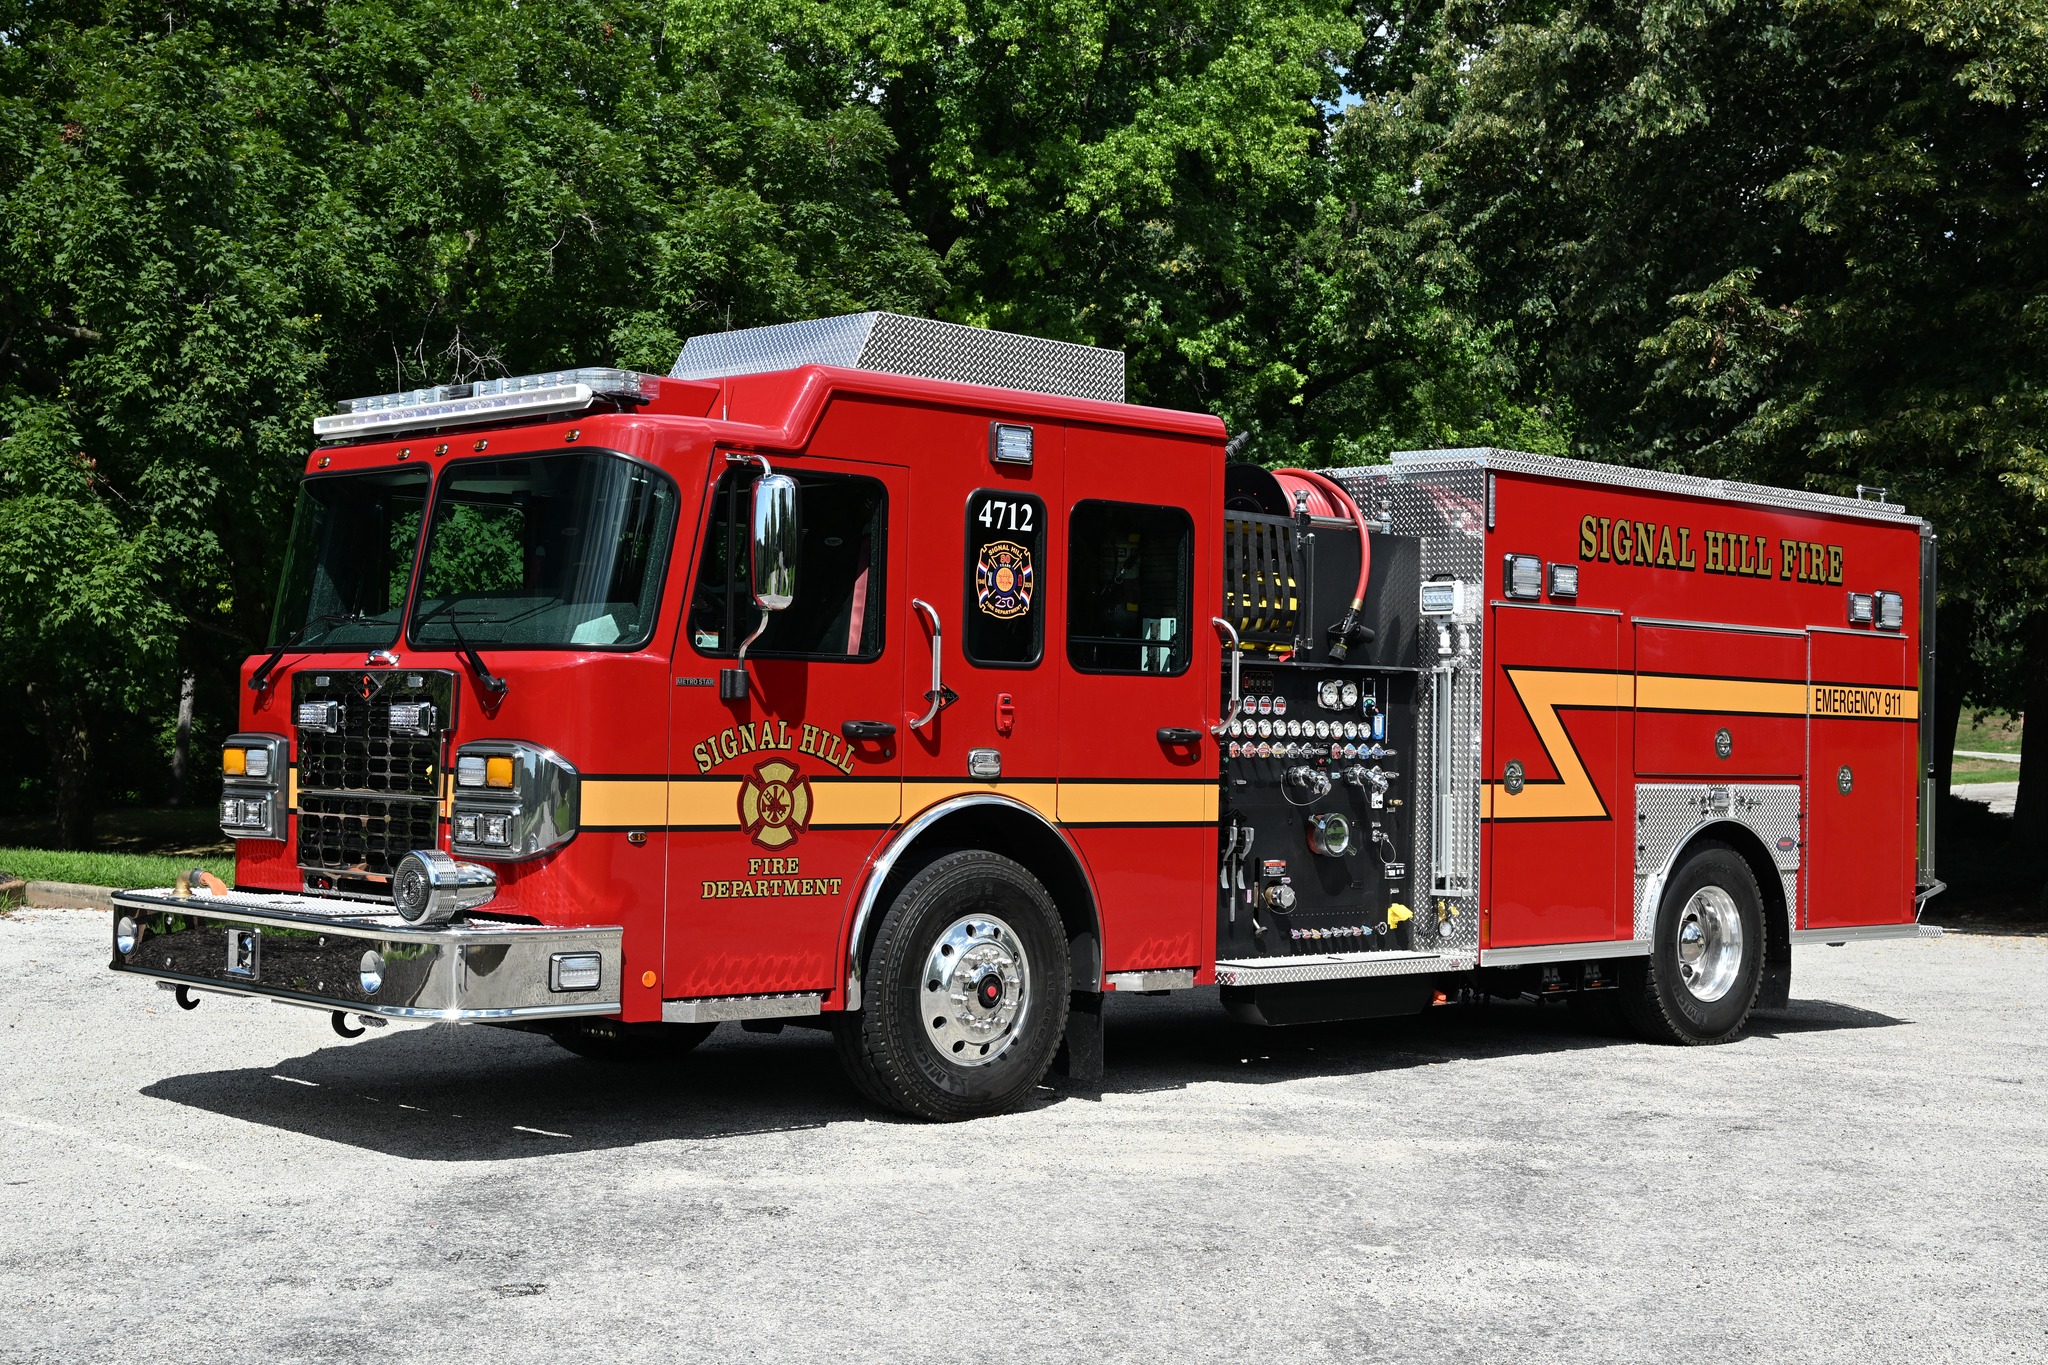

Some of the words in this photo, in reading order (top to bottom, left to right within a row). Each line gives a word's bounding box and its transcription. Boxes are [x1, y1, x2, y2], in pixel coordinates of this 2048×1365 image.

[979, 499, 1033, 532] 4712
[988, 545, 1010, 556] SIGNAL
[1011, 547, 1023, 559] HILL
[1580, 514, 1696, 572] SIGNAL
[1704, 530, 1772, 579] HILL
[1780, 539, 1843, 586] FIRE
[1815, 688, 1882, 715] EMERGENCY
[1885, 692, 1901, 716] 911
[693, 720, 792, 774] SIGNAL
[799, 723, 857, 775] HILL
[748, 857, 800, 876] FIRE
[701, 878, 842, 899] DEPARTMENT
